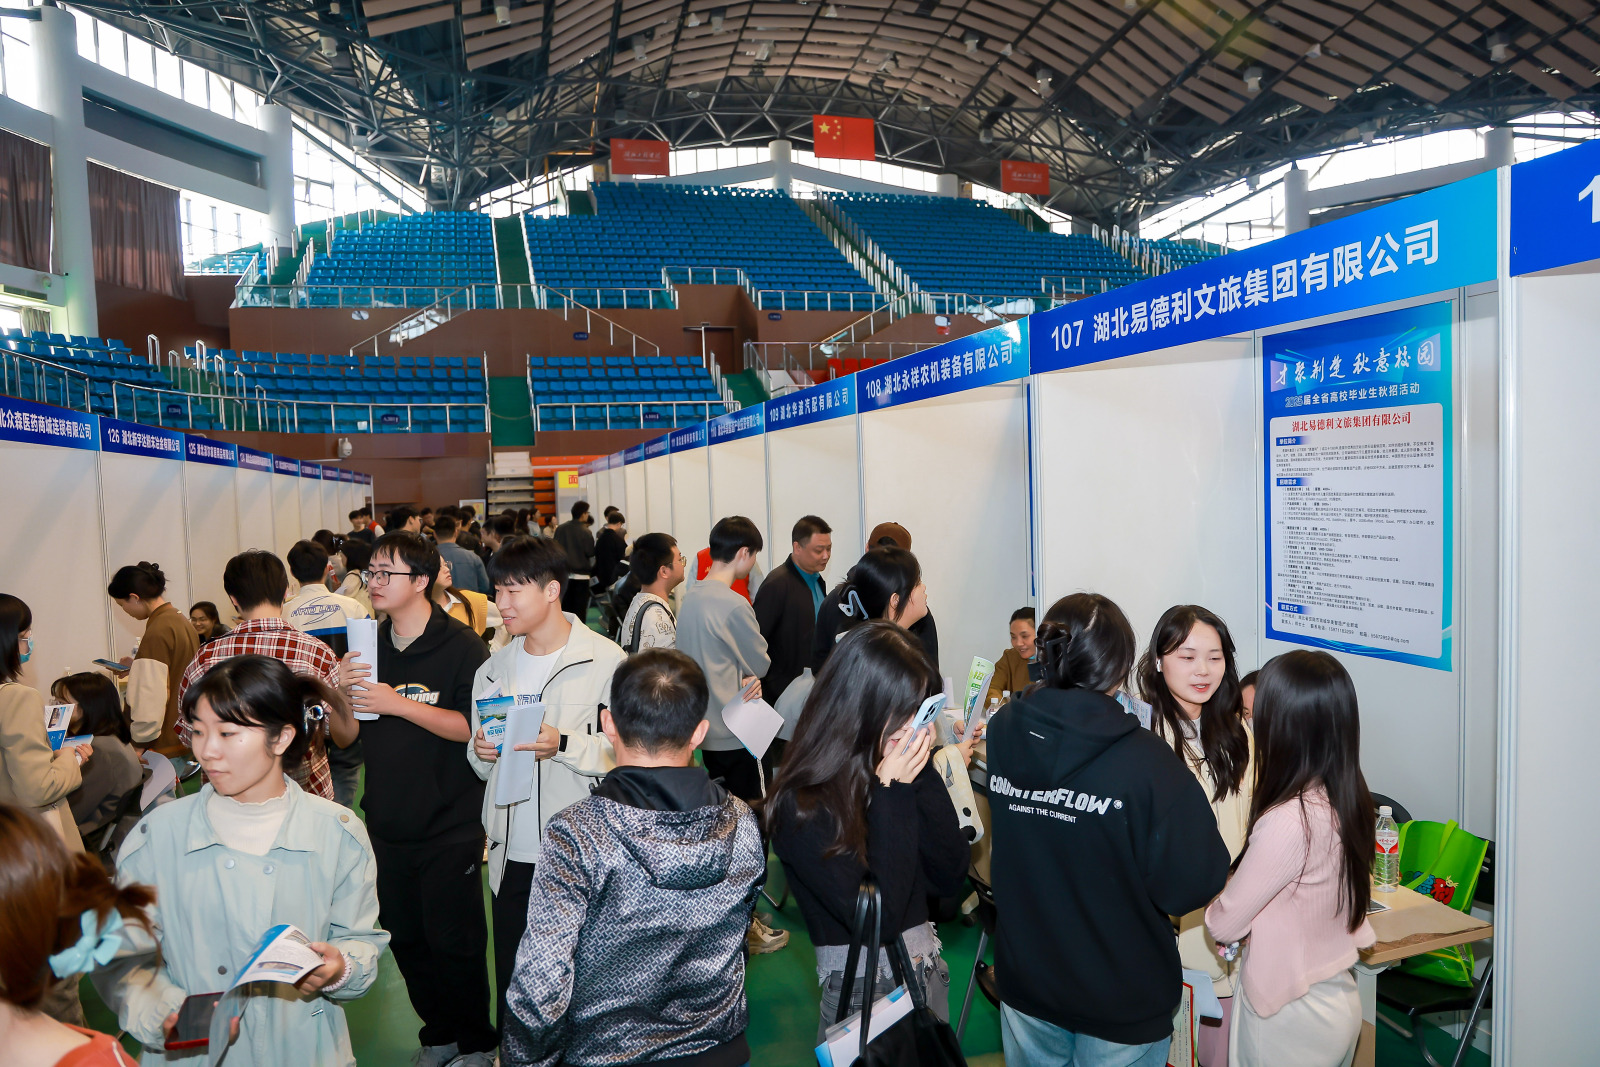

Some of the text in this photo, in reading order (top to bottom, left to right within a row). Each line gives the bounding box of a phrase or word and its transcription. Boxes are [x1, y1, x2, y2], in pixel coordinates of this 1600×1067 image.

[1051, 219, 1440, 352] 107 湖北易德利文旅集团有限公司
[865, 340, 1013, 399] 108 湖北永祥农机装备有限公司
[1285, 382, 1420, 408] 2025届全省高校毕业生秋招活动
[769, 407, 779, 423] 109
[1292, 412, 1411, 433] 湖北易德利文旅集团有限公司
[107, 427, 120, 444] 126
[990, 774, 1112, 815] COUNTERFLOW
[1008, 803, 1077, 824] AGAINST THE CURRENT
